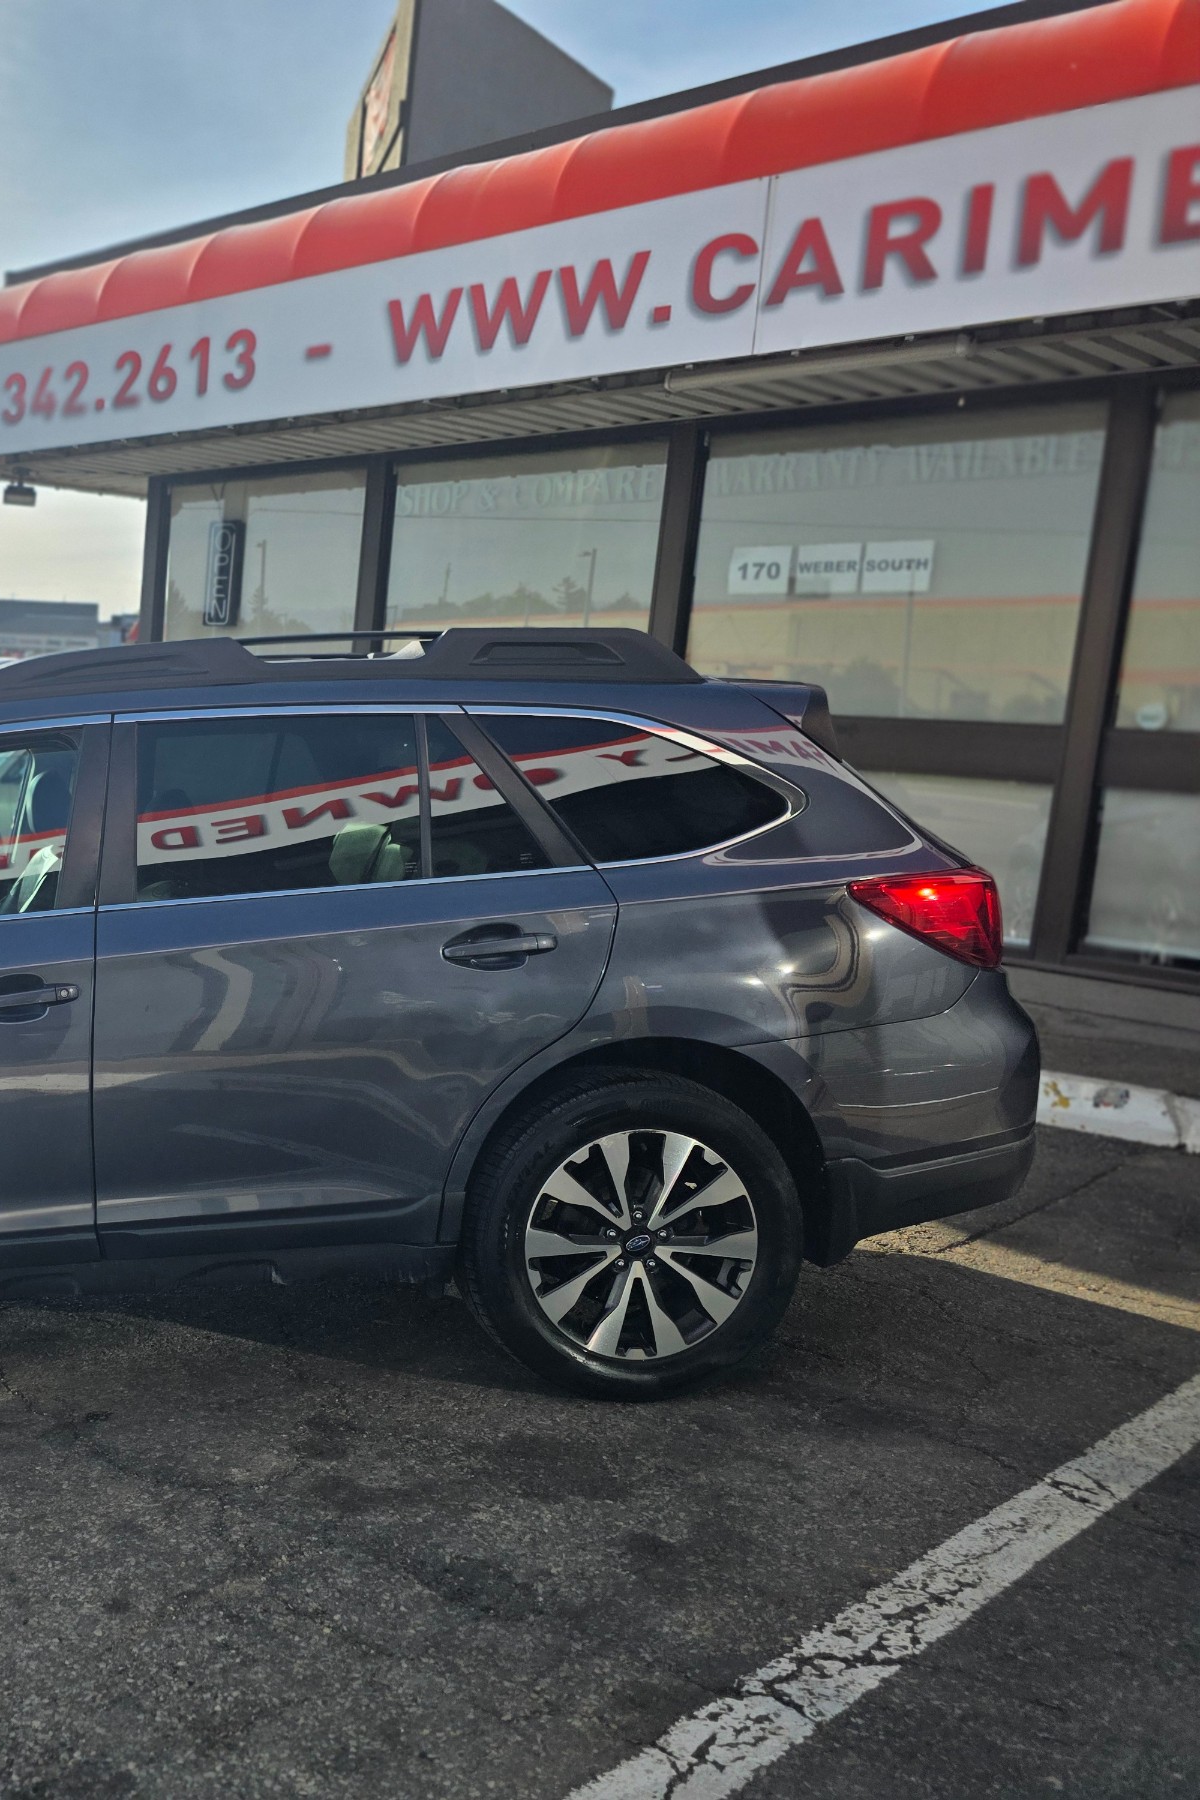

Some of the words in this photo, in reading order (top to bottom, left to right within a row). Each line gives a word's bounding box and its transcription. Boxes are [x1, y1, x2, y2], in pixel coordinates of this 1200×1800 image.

[210, 528, 232, 619] OPEN
[738, 561, 781, 580] 170
[799, 560, 858, 574] WEBER
[865, 558, 929, 572] SOUTH
